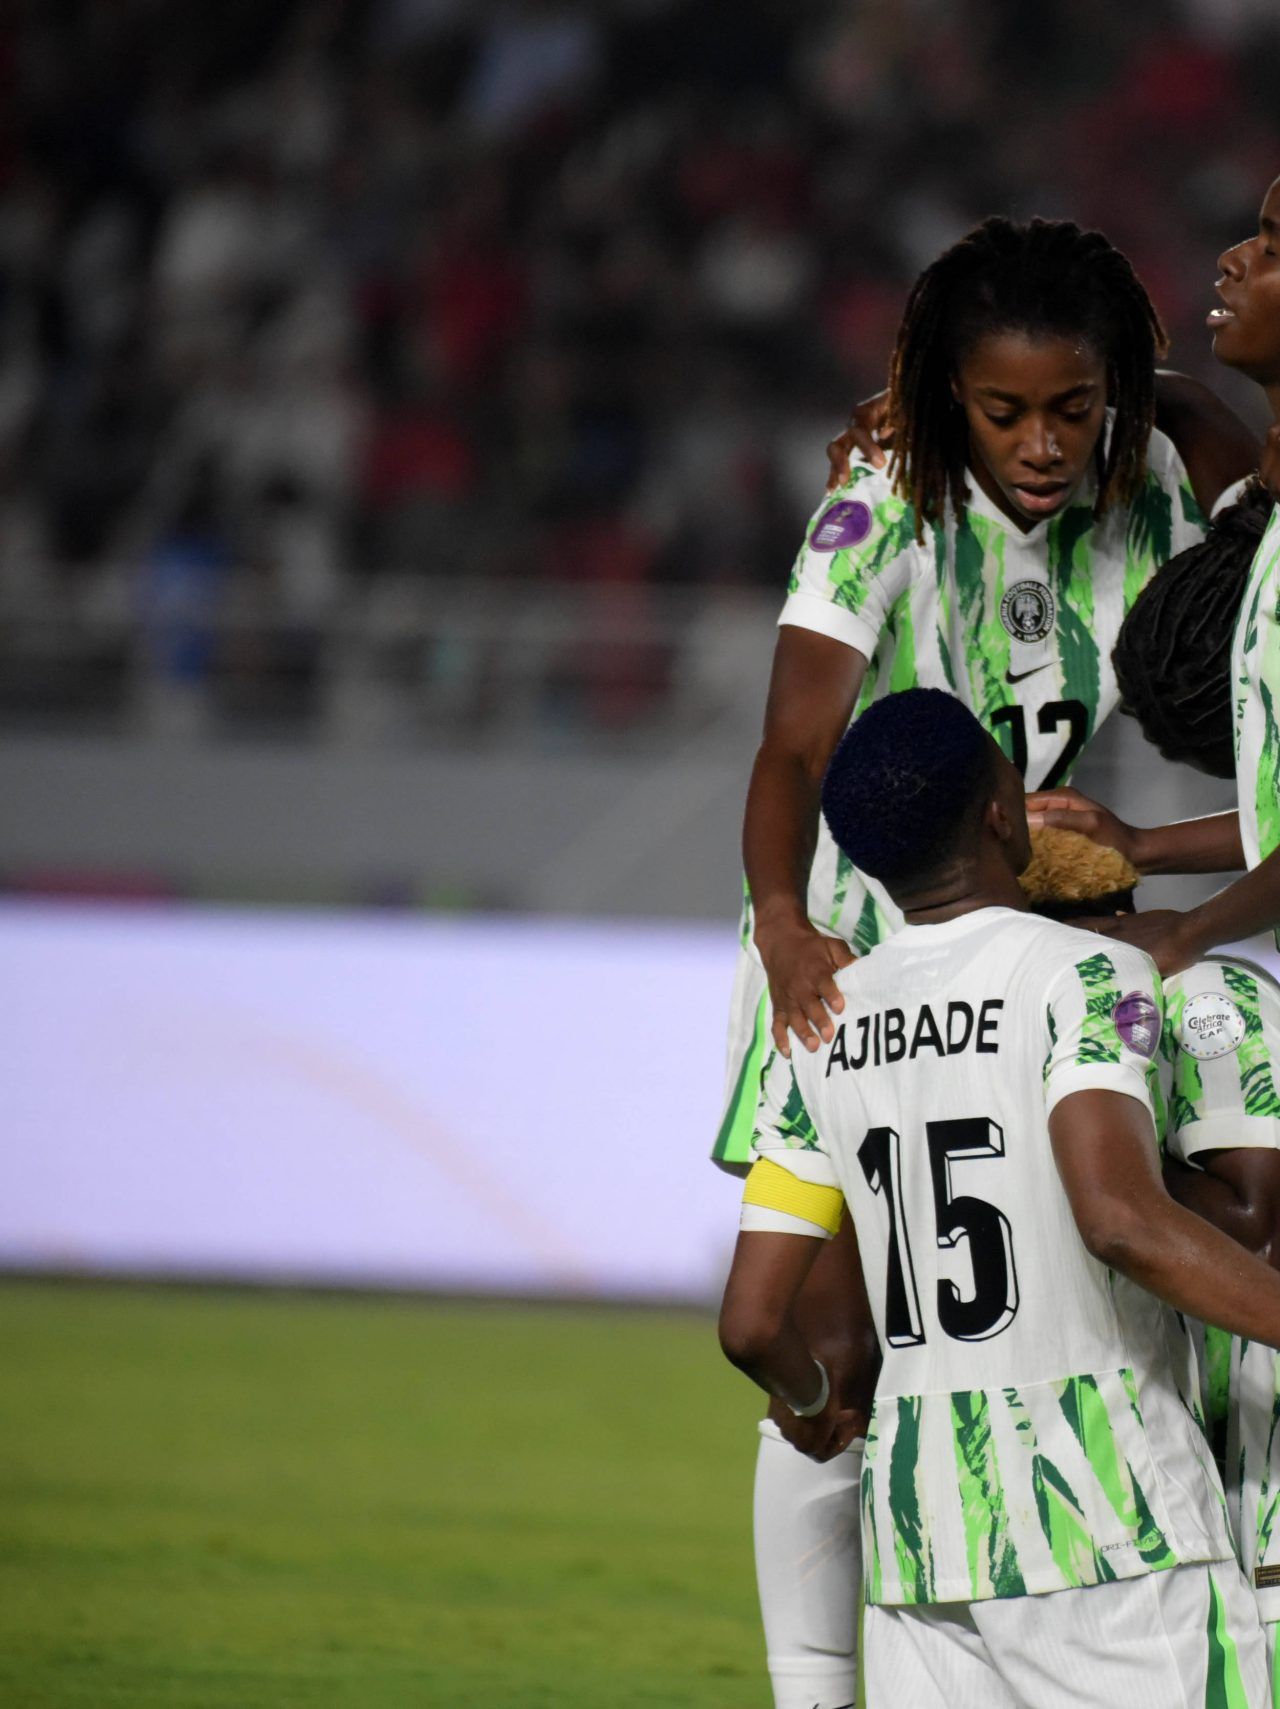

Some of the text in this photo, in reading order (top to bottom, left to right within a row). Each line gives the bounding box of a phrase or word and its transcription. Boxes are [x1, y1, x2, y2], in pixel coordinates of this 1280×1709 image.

[990, 699, 1088, 791] 12
[825, 999, 1004, 1078] AJIBADE
[1188, 1014, 1231, 1030] Celebrate
[1197, 1020, 1223, 1034] Africa
[1199, 1027, 1225, 1040] CAF
[857, 1116, 1020, 1349] 15
